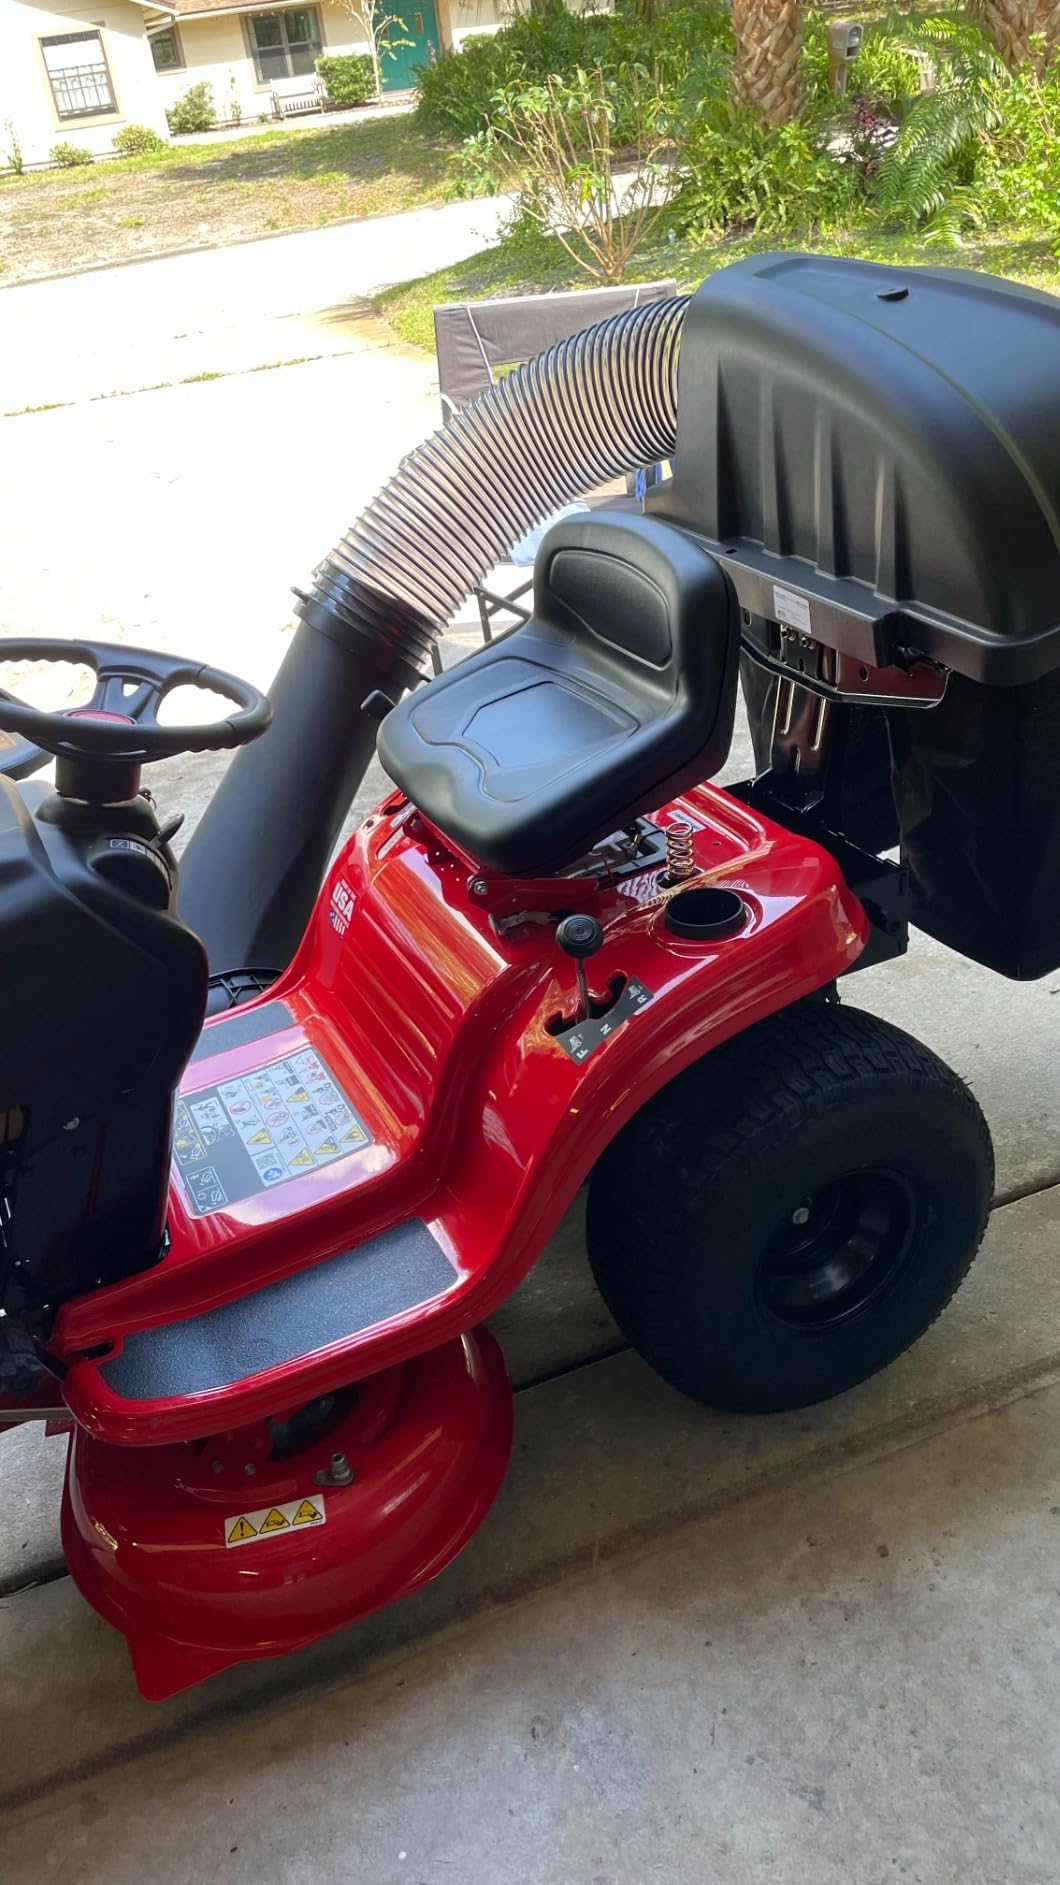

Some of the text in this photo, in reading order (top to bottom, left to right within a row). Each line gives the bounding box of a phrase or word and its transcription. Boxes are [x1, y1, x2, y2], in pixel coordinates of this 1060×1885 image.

[332, 882, 354, 922] USA
[637, 994, 648, 1004] R
[600, 1023, 612, 1035] N
[576, 1048, 589, 1059] F
